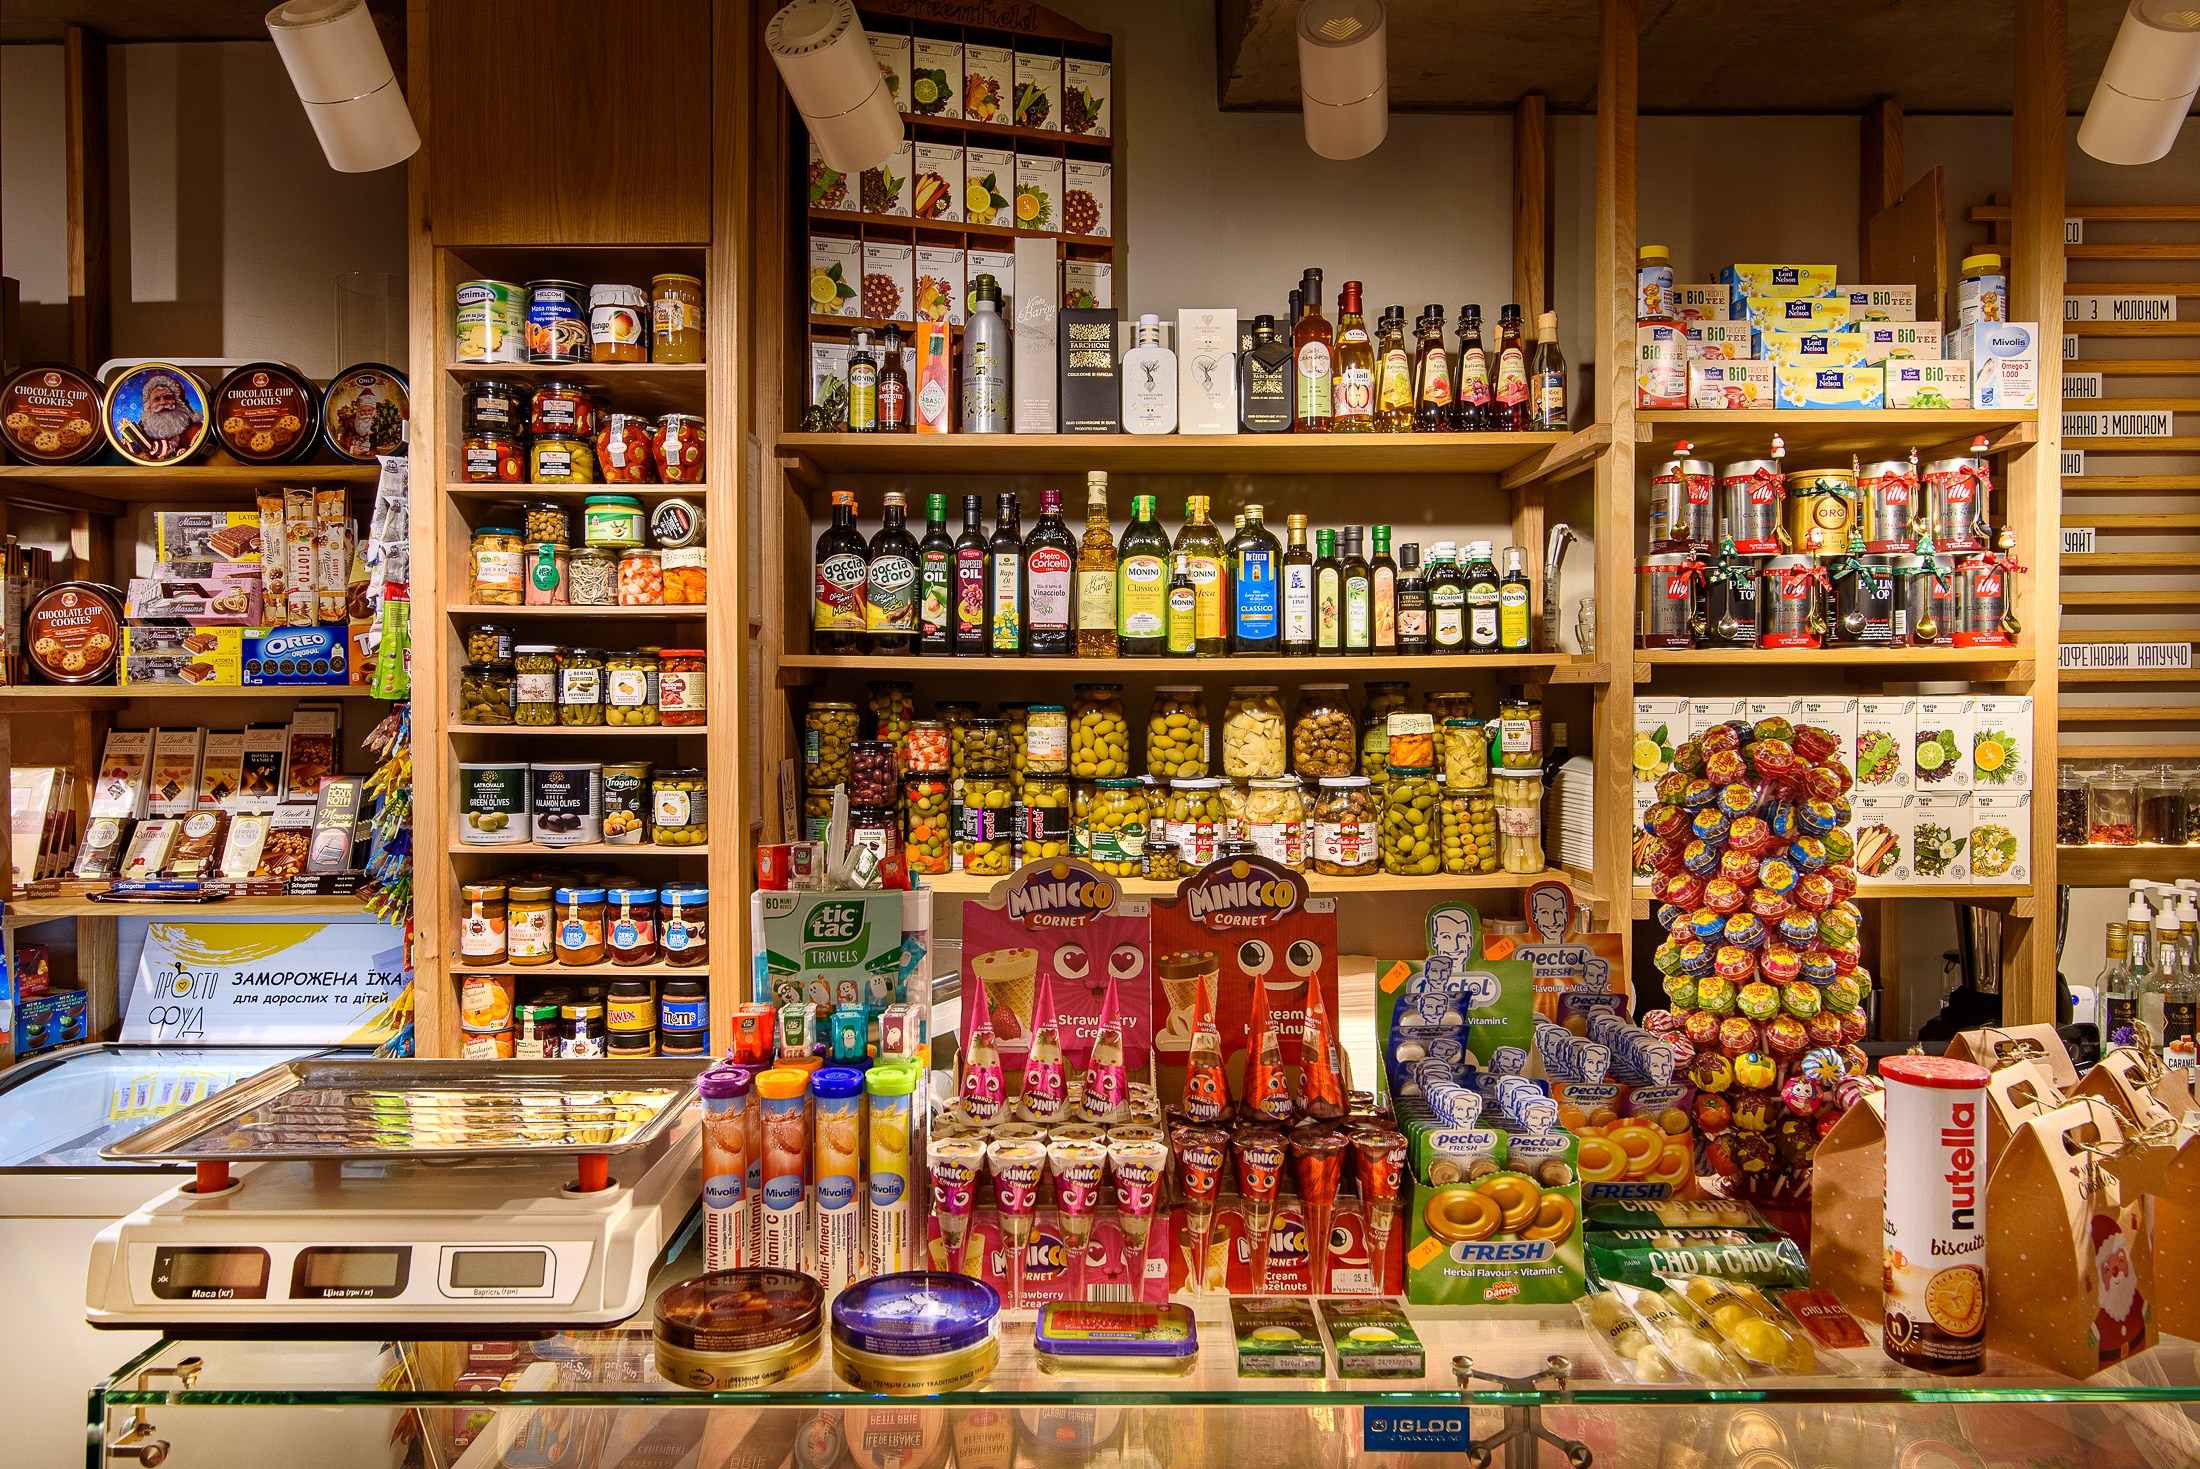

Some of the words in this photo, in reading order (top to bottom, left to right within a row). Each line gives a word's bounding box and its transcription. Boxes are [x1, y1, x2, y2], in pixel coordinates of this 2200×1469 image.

[2090, 300, 2098, 320] З
[2113, 300, 2169, 320] МОЛОКОМ
[1992, 338, 2026, 347] Mivolis
[2001, 363, 2029, 371] Omega-3
[14, 385, 66, 398] CHOCOLATE
[67, 391, 88, 401] CHIP
[228, 389, 274, 399] CHOCOLATE
[275, 388, 294, 397] CHIP
[882, 383, 899, 391] HEINZ
[28, 396, 74, 408] COOKIES
[240, 397, 282, 407] COOKIES
[2101, 415, 2108, 435] З
[2112, 415, 2167, 435] МОЛОКОМ
[1887, 486, 1908, 503] illy
[1948, 484, 1971, 502] illy
[1819, 509, 1846, 518] ORO
[179, 517, 211, 527] Massimo
[2064, 529, 2092, 553] УАЙТ
[1039, 552, 1060, 560] Pietro
[825, 557, 863, 579] goccia
[871, 557, 908, 580] goccia
[924, 562, 946, 571] AVOCADO
[960, 560, 982, 568] GRAPESEED
[1031, 559, 1068, 569] Coricelli
[837, 569, 864, 581] d'oro
[881, 569, 911, 583] d'oro
[924, 572, 947, 582] OIL
[960, 569, 982, 579] OIL
[1128, 567, 1159, 575] MONINI
[1033, 589, 1066, 597] Vinacciolo
[1127, 584, 1160, 592] Classico
[1976, 579, 2000, 595] illy
[38, 608, 84, 620] CHOCOLATE
[84, 606, 103, 616] CHIP
[170, 604, 204, 613] Massimo
[832, 602, 853, 617] Mais
[883, 600, 904, 614] Soia
[51, 616, 92, 627] COOKIES
[266, 634, 326, 654] OREO
[292, 648, 319, 658] ORIGINAL
[2137, 645, 2188, 666] КАПУЧЧО
[470, 799, 488, 807] GREEN
[488, 799, 510, 807] OLIVES
[560, 799, 580, 807] OLIVES
[134, 824, 169, 839] Raffaello
[1008, 878, 1112, 913] MINICCO
[1190, 878, 1294, 912] MINICCO
[766, 898, 778, 909] 60
[822, 905, 856, 923] tic
[1033, 914, 1086, 927] CORNET
[1215, 913, 1266, 927] CORNET
[813, 920, 854, 937] tac
[811, 951, 858, 964] TRAVELS
[232, 972, 358, 986] ЗАМОРОЖЕНА
[367, 970, 402, 986] ЇЖА
[1536, 968, 1571, 976] FRESH
[233, 994, 258, 1004] для
[263, 994, 328, 1006] дорослих
[334, 995, 347, 1004] та
[353, 992, 389, 1005] дітей
[1468, 1017, 1501, 1025] Vitamin
[1503, 1017, 1508, 1025] C
[2168, 1057, 2195, 1069] CARAMEL
[1566, 1086, 1615, 1099] pectol
[1438, 1133, 1489, 1147] pectol
[1509, 1136, 1562, 1149] pectol
[934, 1164, 974, 1180] MINICCO
[1942, 1102, 1975, 1231] nutella
[706, 1186, 740, 1196] Mivolis
[766, 1187, 800, 1197] Mivolis
[819, 1186, 852, 1196] Mivolis
[1591, 1182, 1664, 1199] FRESH
[1461, 1242, 1546, 1260] FRESH
[1930, 1234, 1985, 1256] biscuits
[819, 1214, 829, 1290] Multi-Mineral
[1649, 1251, 1698, 1275] CHO
[1704, 1250, 1722, 1275] A
[1723, 1249, 1773, 1274] CHO
[1265, 1272, 1298, 1280] Cream
[1443, 1267, 1474, 1278] Herbal
[1477, 1268, 1511, 1278] Flavour
[1521, 1266, 1554, 1277] Vitamin
[1557, 1266, 1563, 1274] C
[191, 1289, 217, 1299] Маса
[218, 1288, 234, 1299] (кг)
[323, 1288, 345, 1298] Ціна
[346, 1289, 360, 1298] (грн
[473, 1288, 501, 1297] Вартість
[501, 1288, 519, 1297] (грн)
[1484, 1285, 1519, 1300] Damel
[873, 1380, 902, 1389] PREMIUM
[926, 1376, 958, 1388] TRADITION
[959, 1371, 974, 1381] SINCE
[1393, 1419, 1462, 1432] IGLOO
